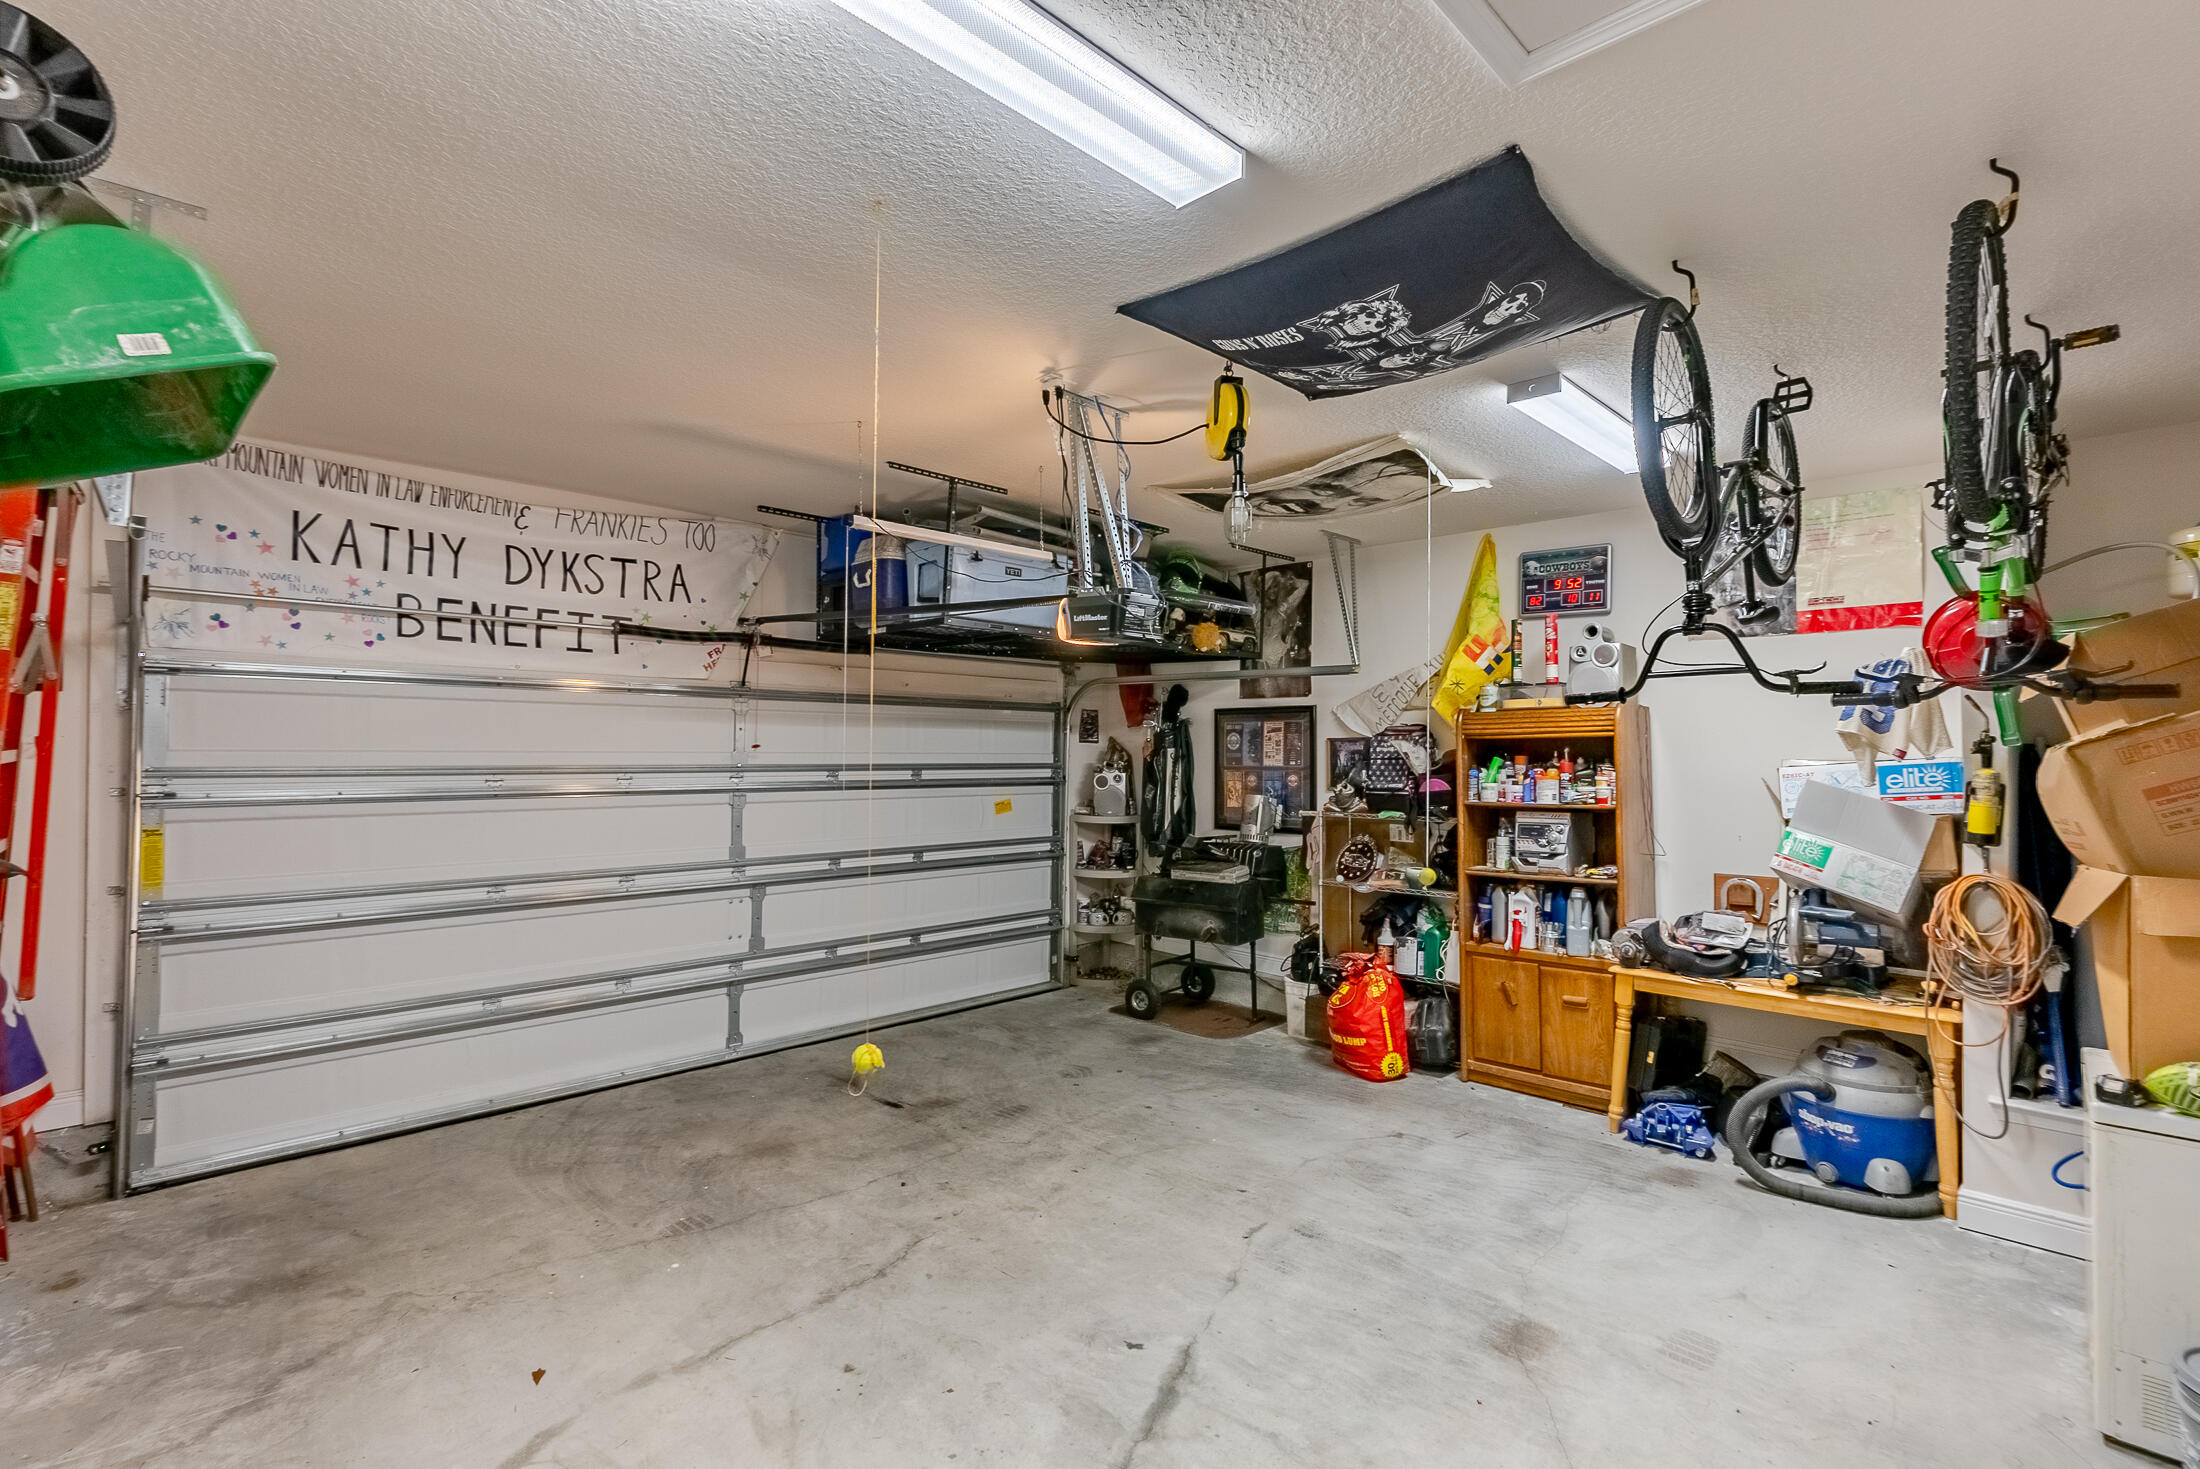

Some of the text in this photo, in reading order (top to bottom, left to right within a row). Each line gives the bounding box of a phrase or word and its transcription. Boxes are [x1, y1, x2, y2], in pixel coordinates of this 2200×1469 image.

[1255, 327, 1305, 349] ROSES
[226, 443, 304, 484] MOUNTAIN
[314, 459, 368, 494] WOMEN
[376, 473, 390, 498] IN
[395, 478, 425, 503] LAW
[554, 506, 668, 546] FRANKIES
[678, 519, 716, 553] TOO
[148, 549, 197, 563] ROCKY
[291, 510, 692, 604] KATHY DYKSTRA
[188, 564, 301, 583] MOUNTAIN WOMEN
[1005, 567, 1021, 577] YETI
[1538, 560, 1591, 574] COWBOYS
[303, 586, 330, 596] LAW
[1589, 592, 1601, 601] 11
[1529, 596, 1543, 606] 82
[396, 592, 633, 655] BENEFIT
[1885, 767, 1944, 789] elite
